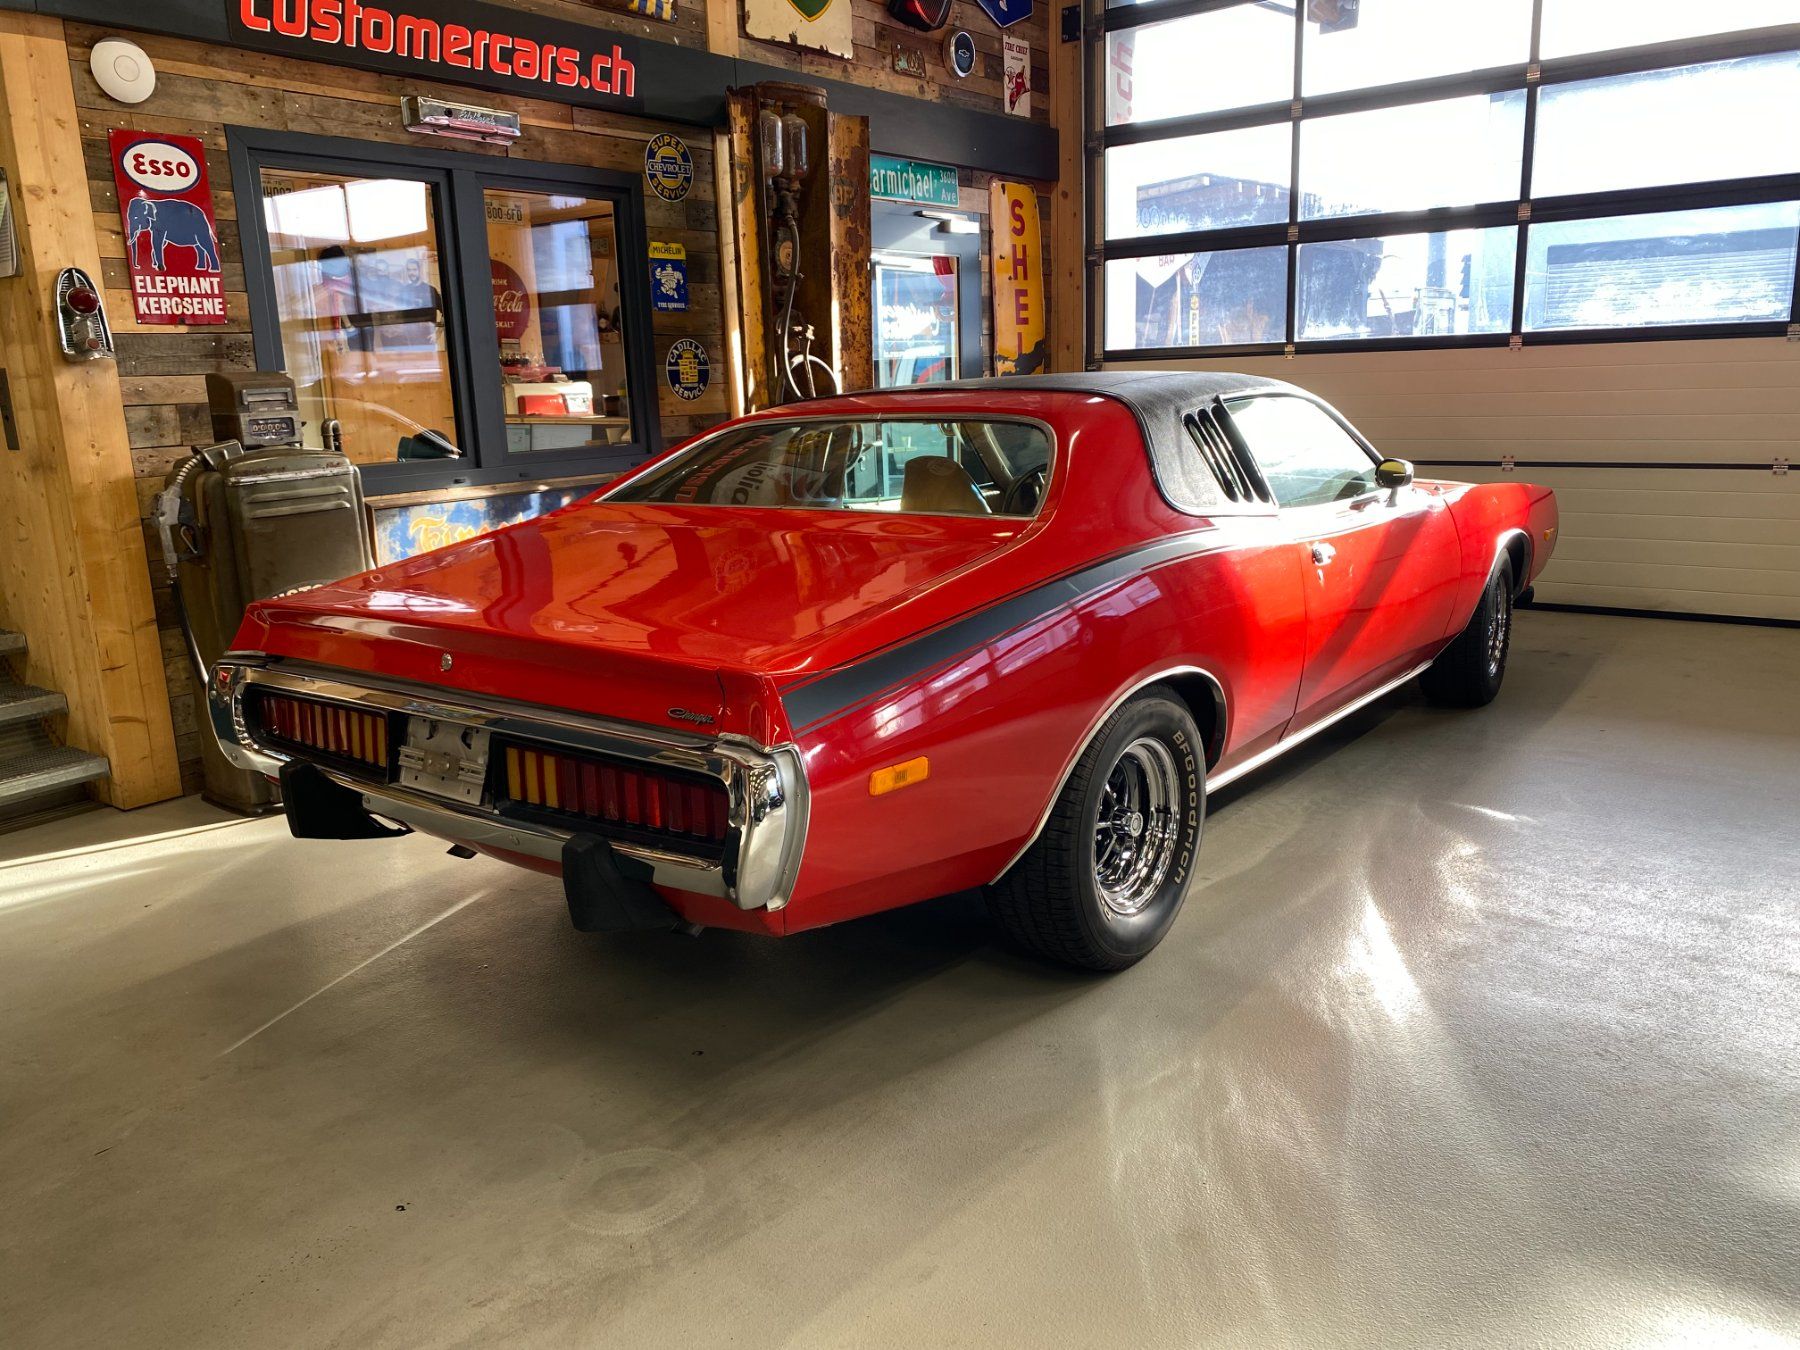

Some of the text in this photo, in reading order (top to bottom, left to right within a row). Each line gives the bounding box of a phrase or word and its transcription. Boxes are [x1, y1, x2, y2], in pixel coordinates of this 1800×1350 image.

[651, 135, 685, 154] SUPER
[649, 161, 690, 174] CHEVROLET
[652, 178, 690, 199] SERVICE
[870, 164, 934, 199] armichael
[941, 188, 957, 202] Ave
[652, 246, 682, 255] MICHELIN
[134, 275, 221, 295] ELEPHANT
[137, 296, 225, 315] KEROSENE
[670, 341, 707, 363] CADILLAC
[673, 383, 706, 399] SERVICE
[1172, 729, 1198, 885] BFGoodrich
